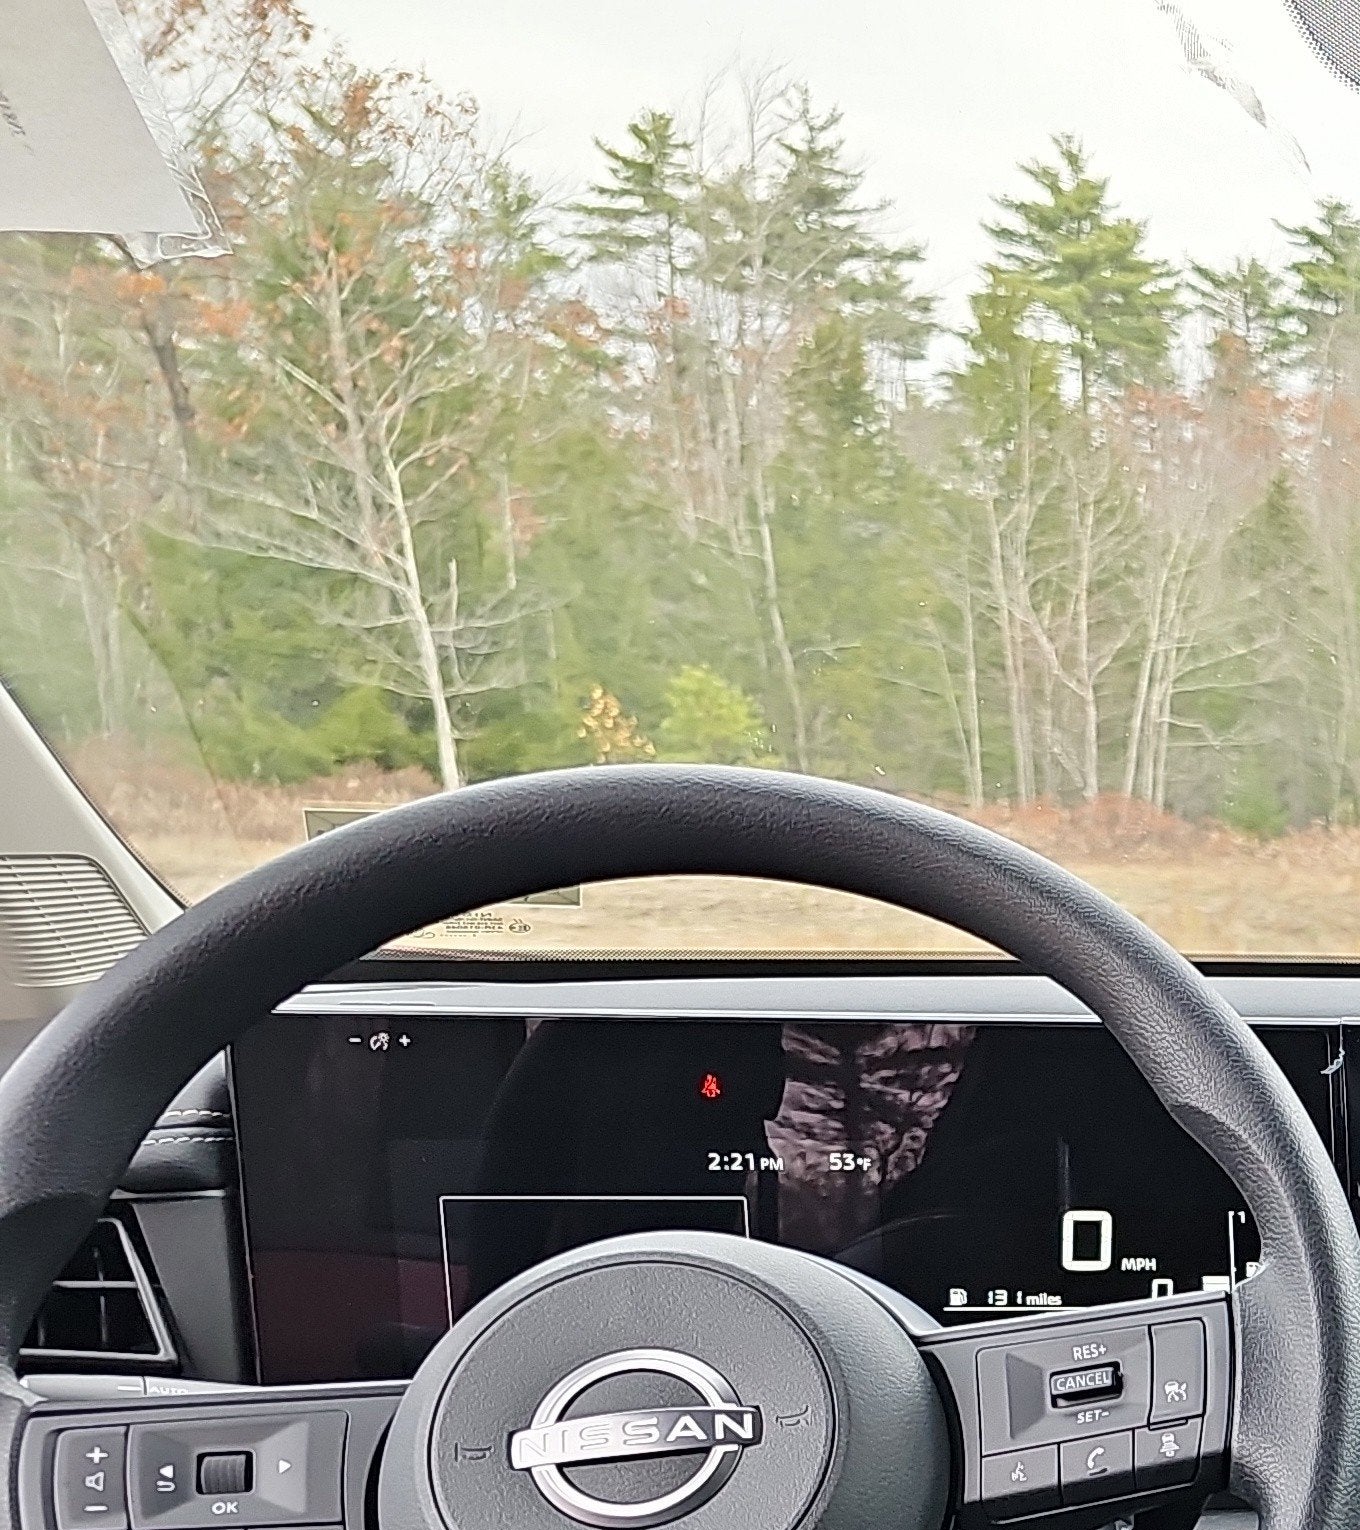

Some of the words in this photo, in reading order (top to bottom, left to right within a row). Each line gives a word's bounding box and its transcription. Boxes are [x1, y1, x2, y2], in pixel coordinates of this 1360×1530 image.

[707, 1152, 756, 1171] 2:21
[760, 1157, 784, 1171] PM
[1061, 1209, 1113, 1272] 0
[1120, 1257, 1157, 1272] MPH
[1026, 1291, 1062, 1306] miles
[1055, 1370, 1110, 1391] CANCEL
[518, 1412, 754, 1463] NISSAN
[210, 1501, 239, 1515] OK
